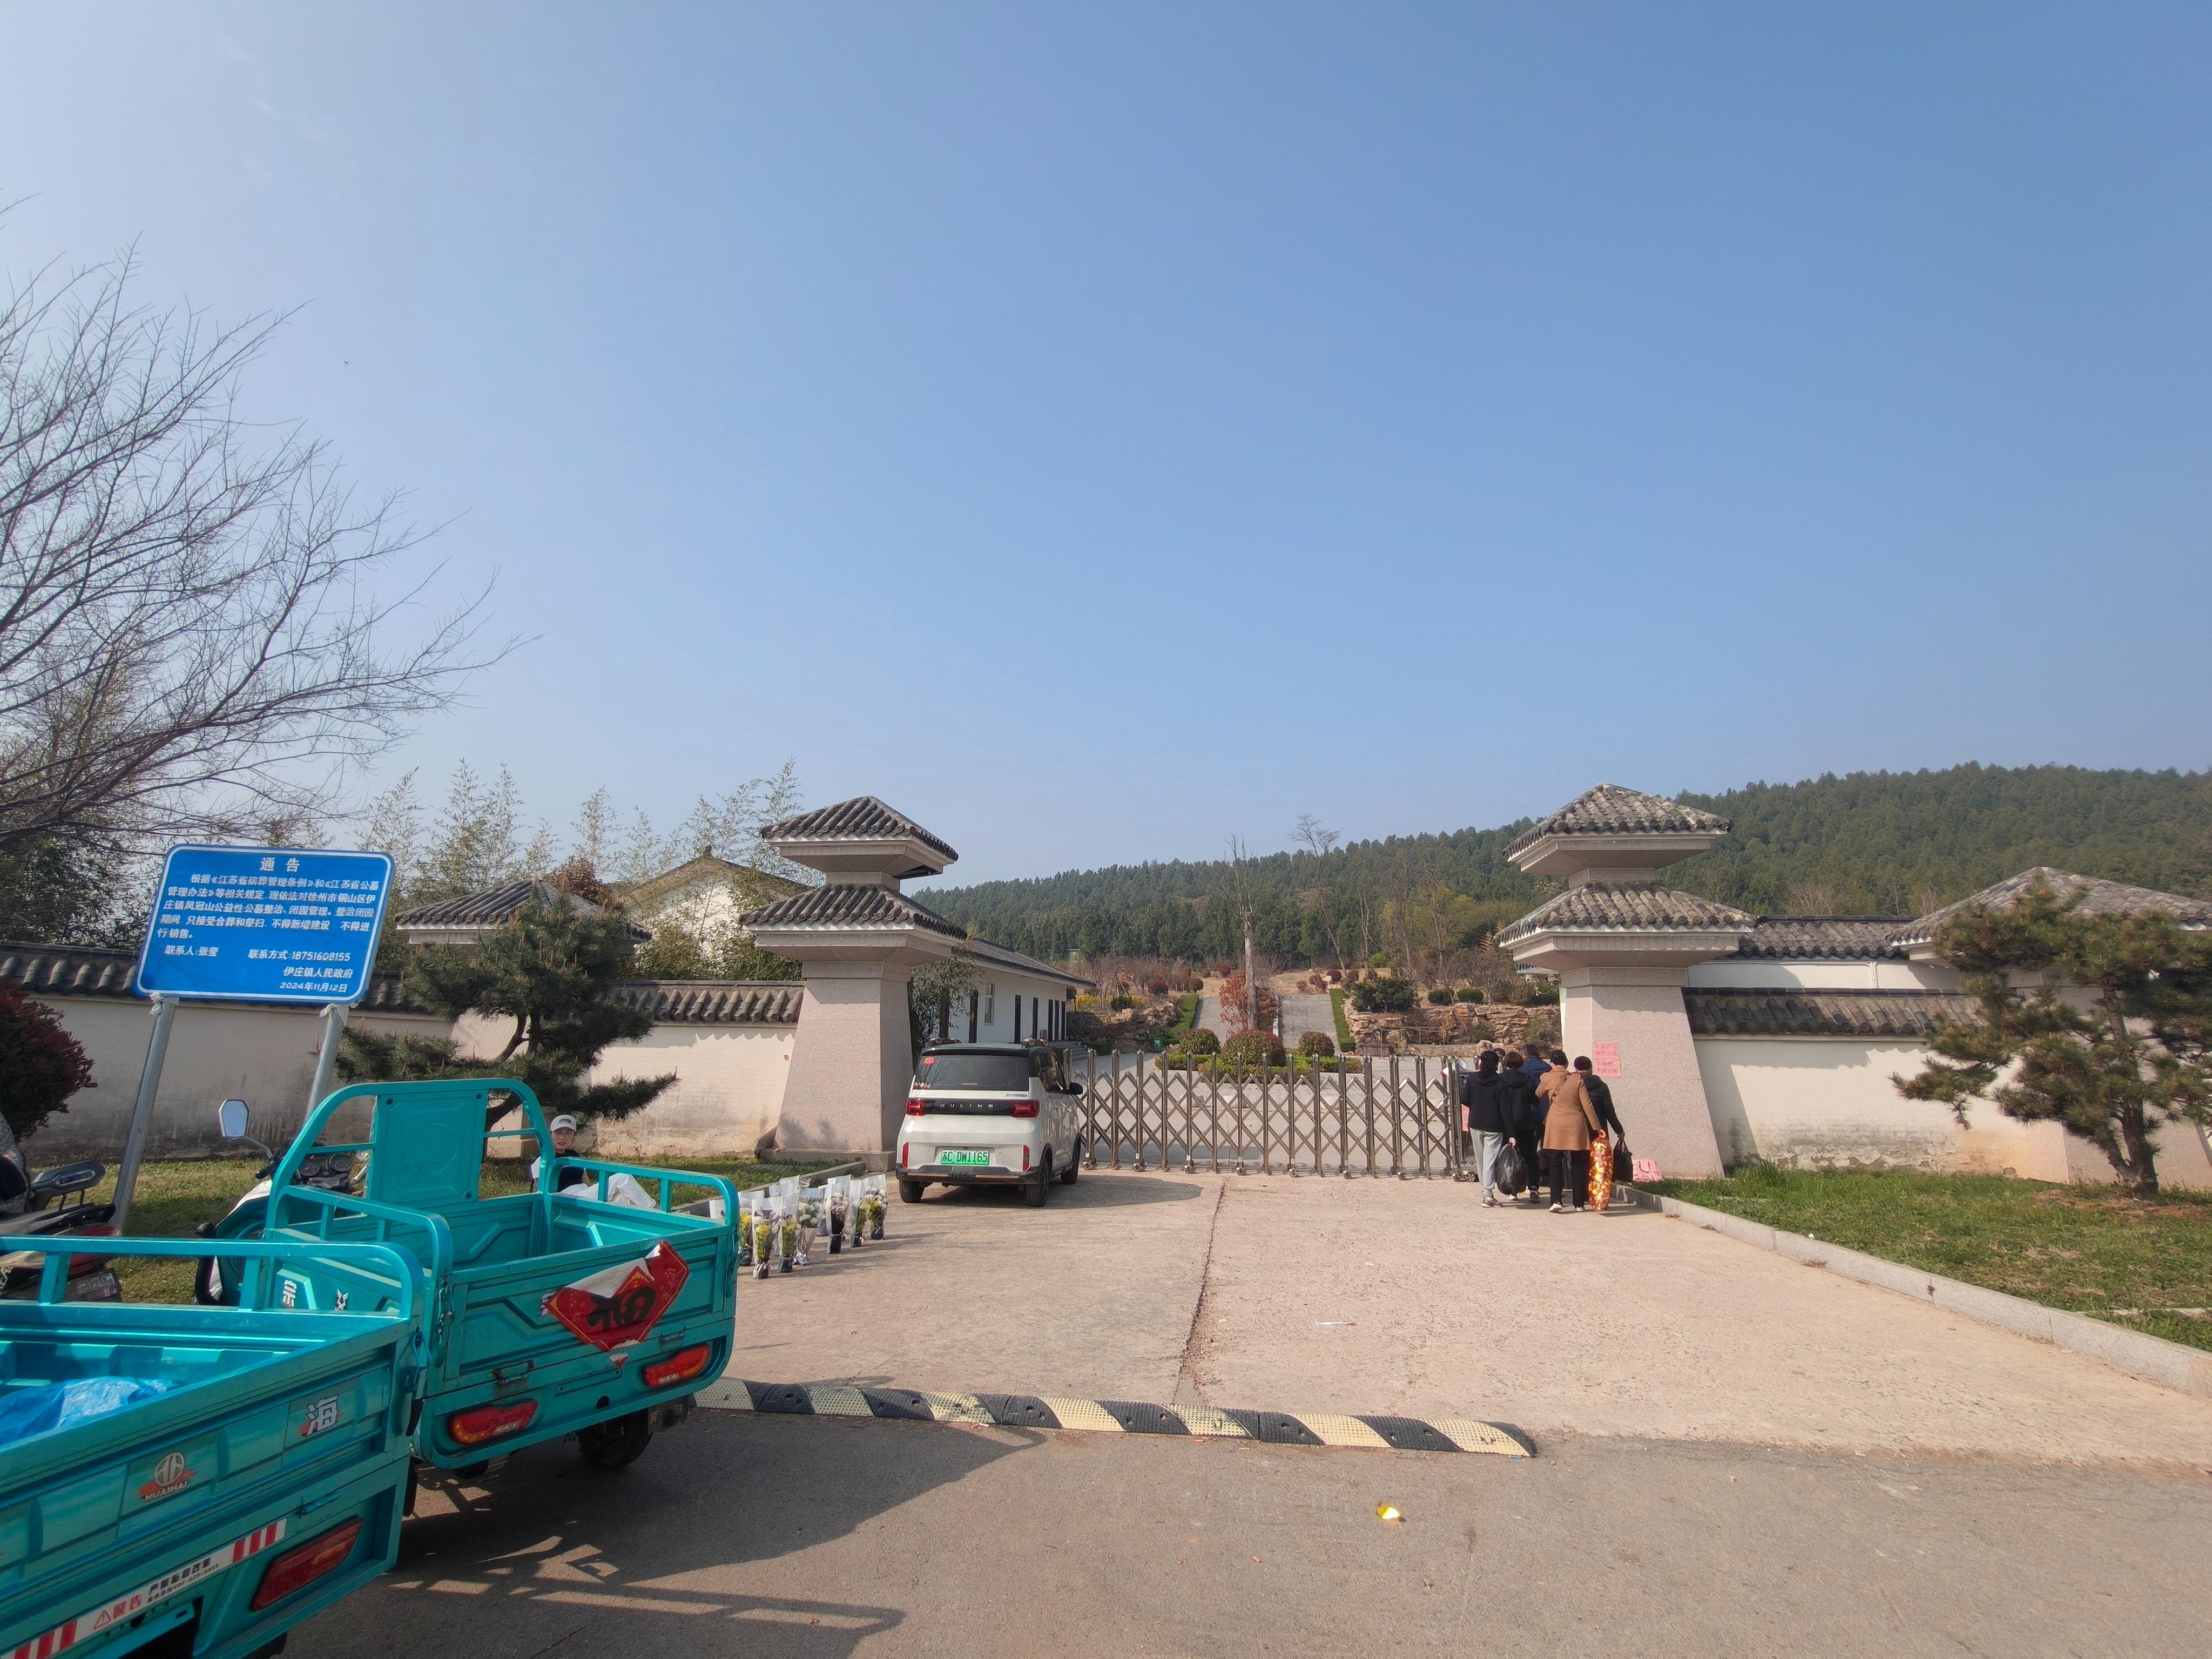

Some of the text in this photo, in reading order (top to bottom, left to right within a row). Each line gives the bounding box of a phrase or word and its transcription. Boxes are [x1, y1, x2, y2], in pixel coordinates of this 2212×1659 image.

[284, 966, 354, 979] 伊庄镇人民政府
[280, 981, 348, 993] 2024年11月12日
[305, 1393, 339, 1437] 海
